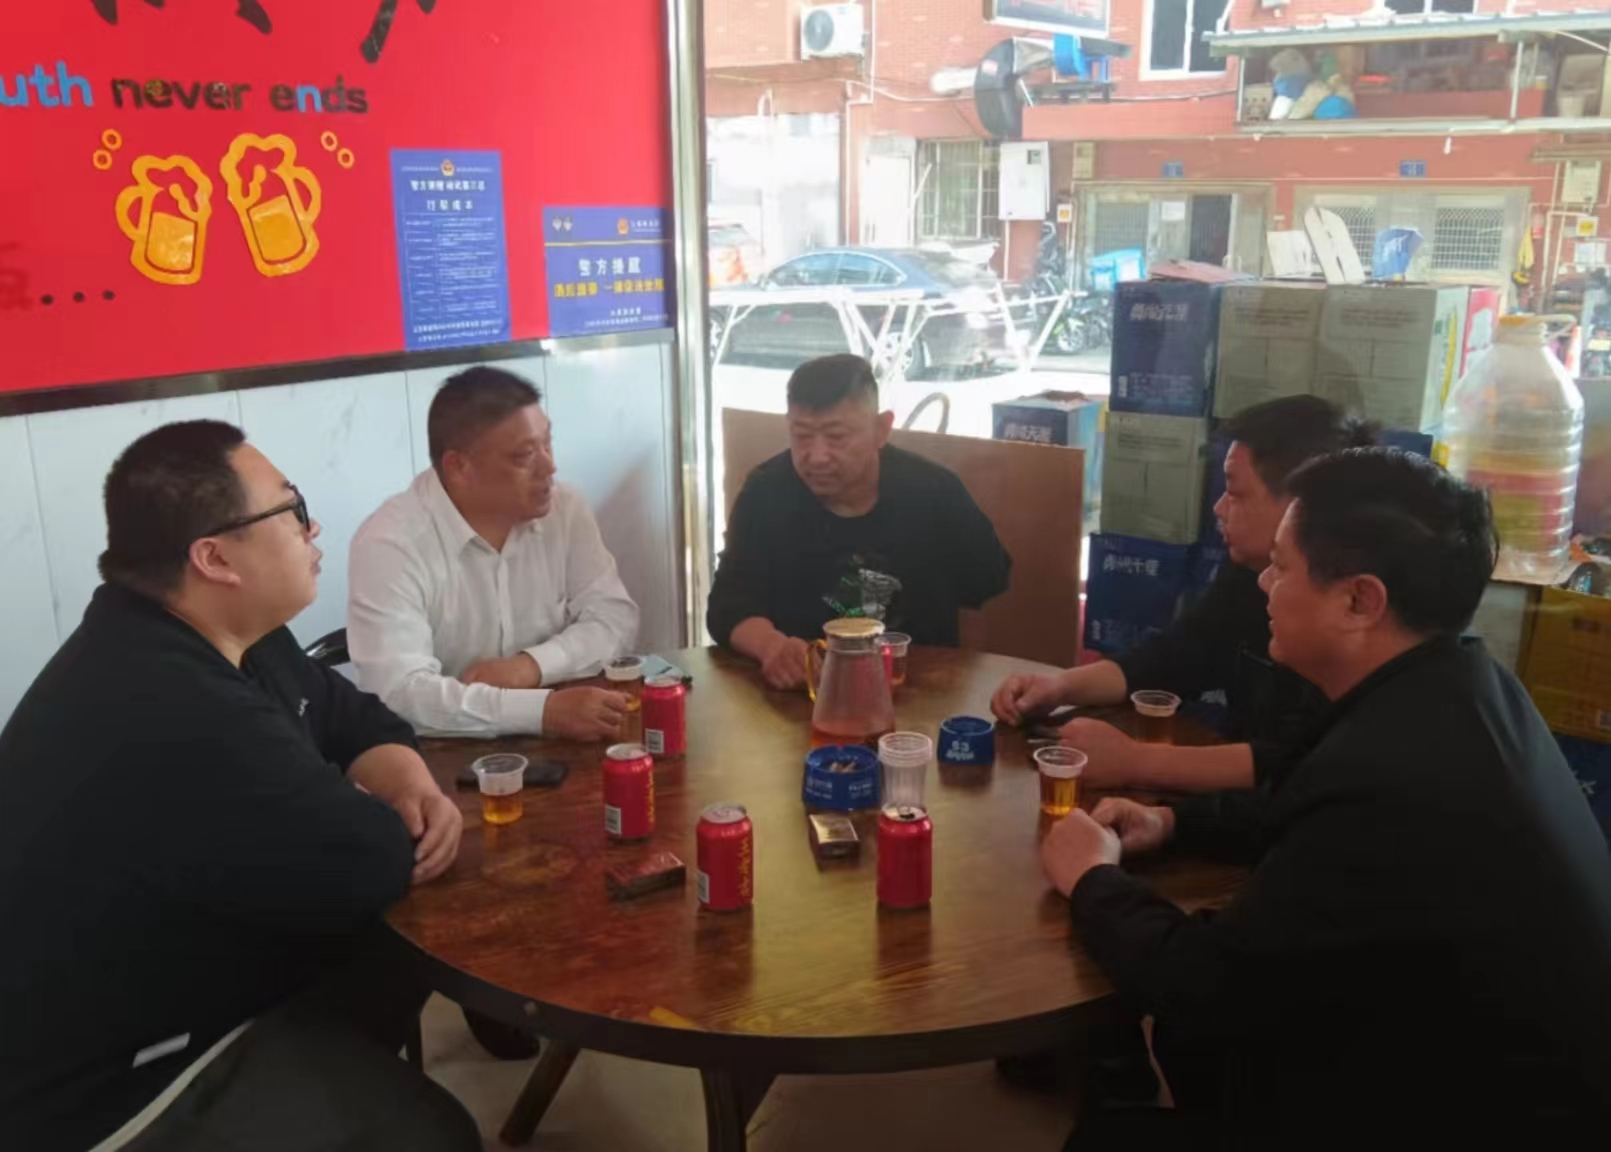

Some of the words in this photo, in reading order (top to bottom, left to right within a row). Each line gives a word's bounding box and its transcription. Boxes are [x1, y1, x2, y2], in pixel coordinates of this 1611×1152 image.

[0, 60, 93, 108] uth
[111, 78, 252, 112] never
[269, 74, 368, 113] ends
